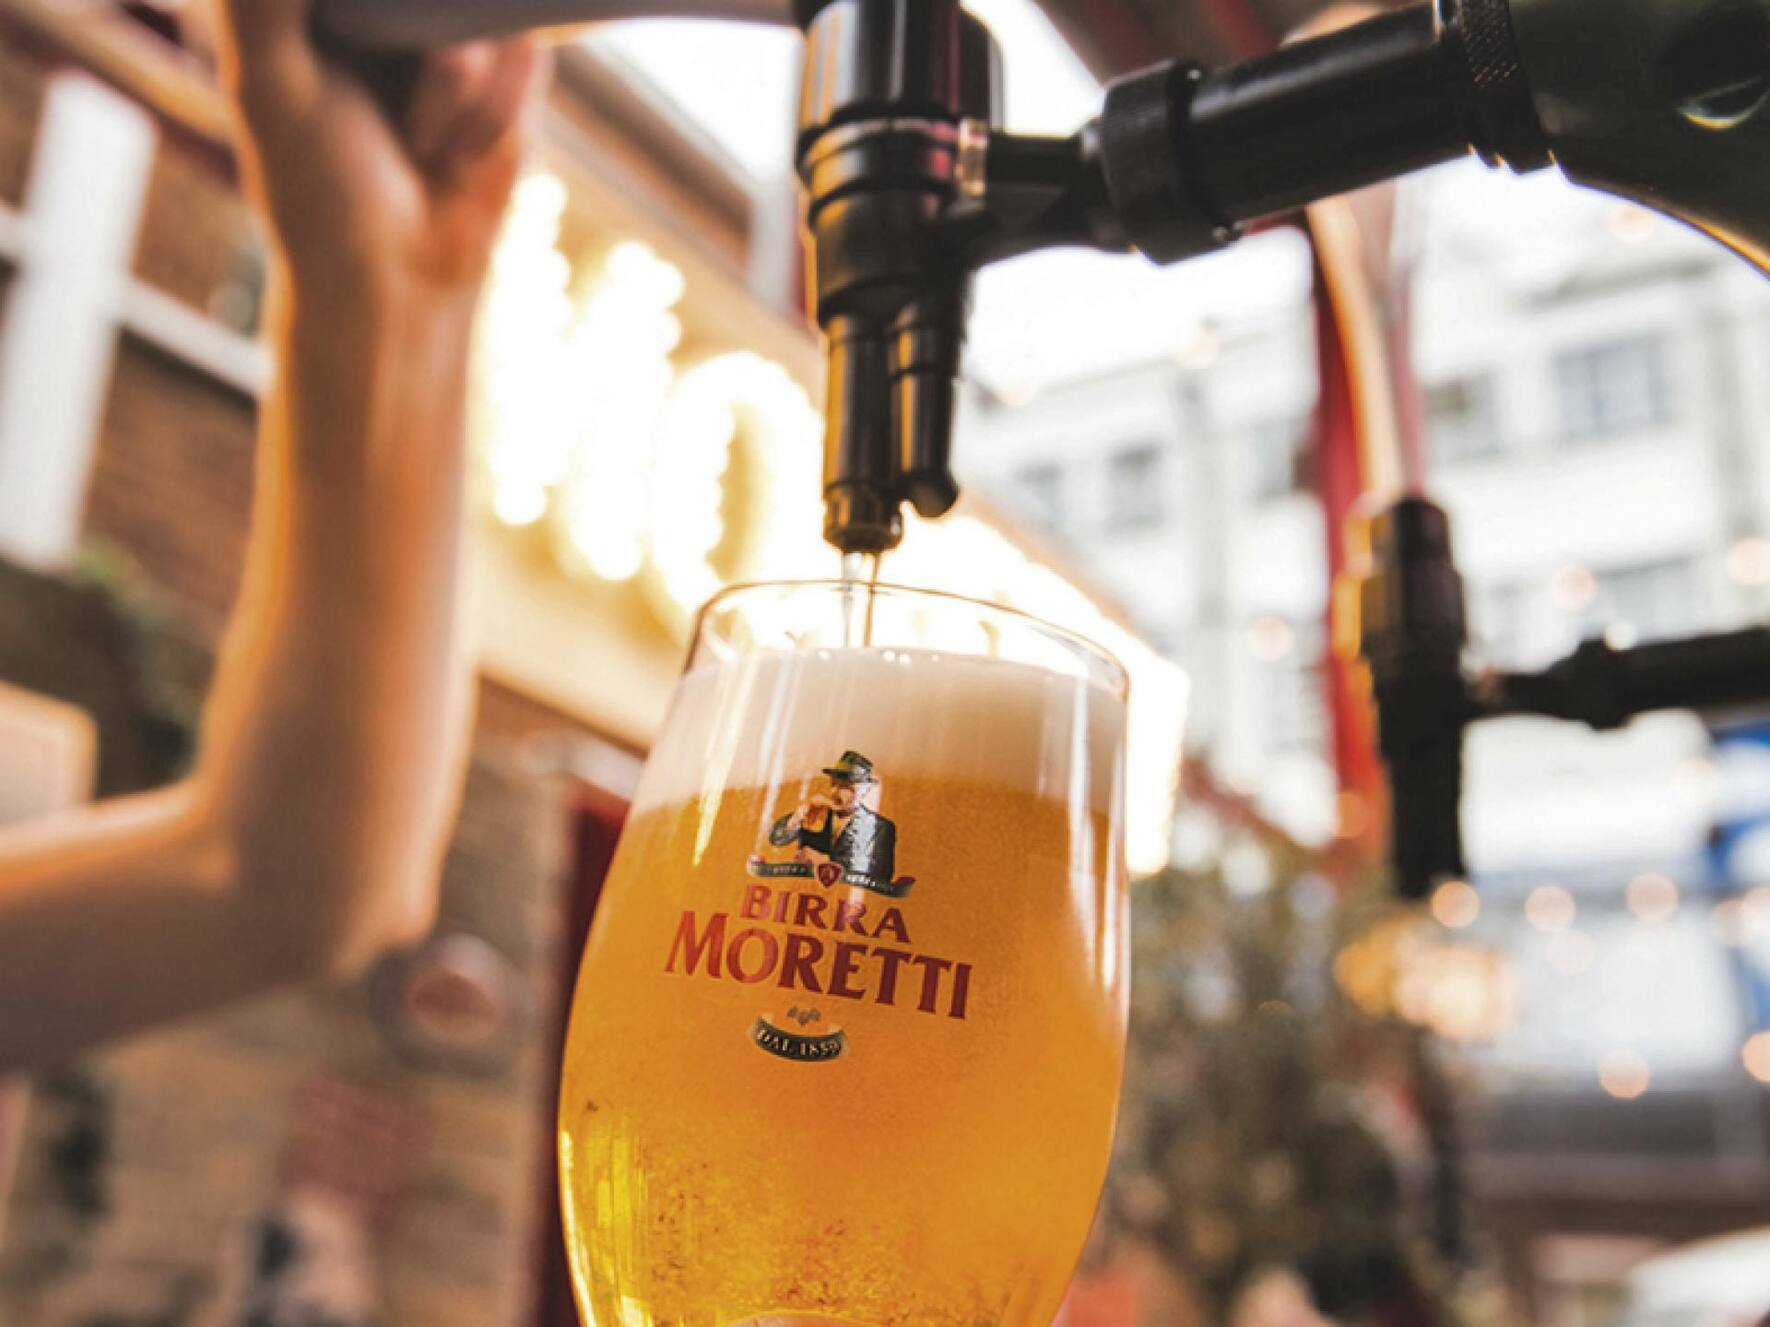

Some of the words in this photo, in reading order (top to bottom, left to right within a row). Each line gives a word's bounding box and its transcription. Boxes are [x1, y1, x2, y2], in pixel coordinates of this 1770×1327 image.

[740, 884, 911, 943] BIRRA
[664, 910, 973, 1019] MORETTI
[756, 1029, 792, 1052] DAL
